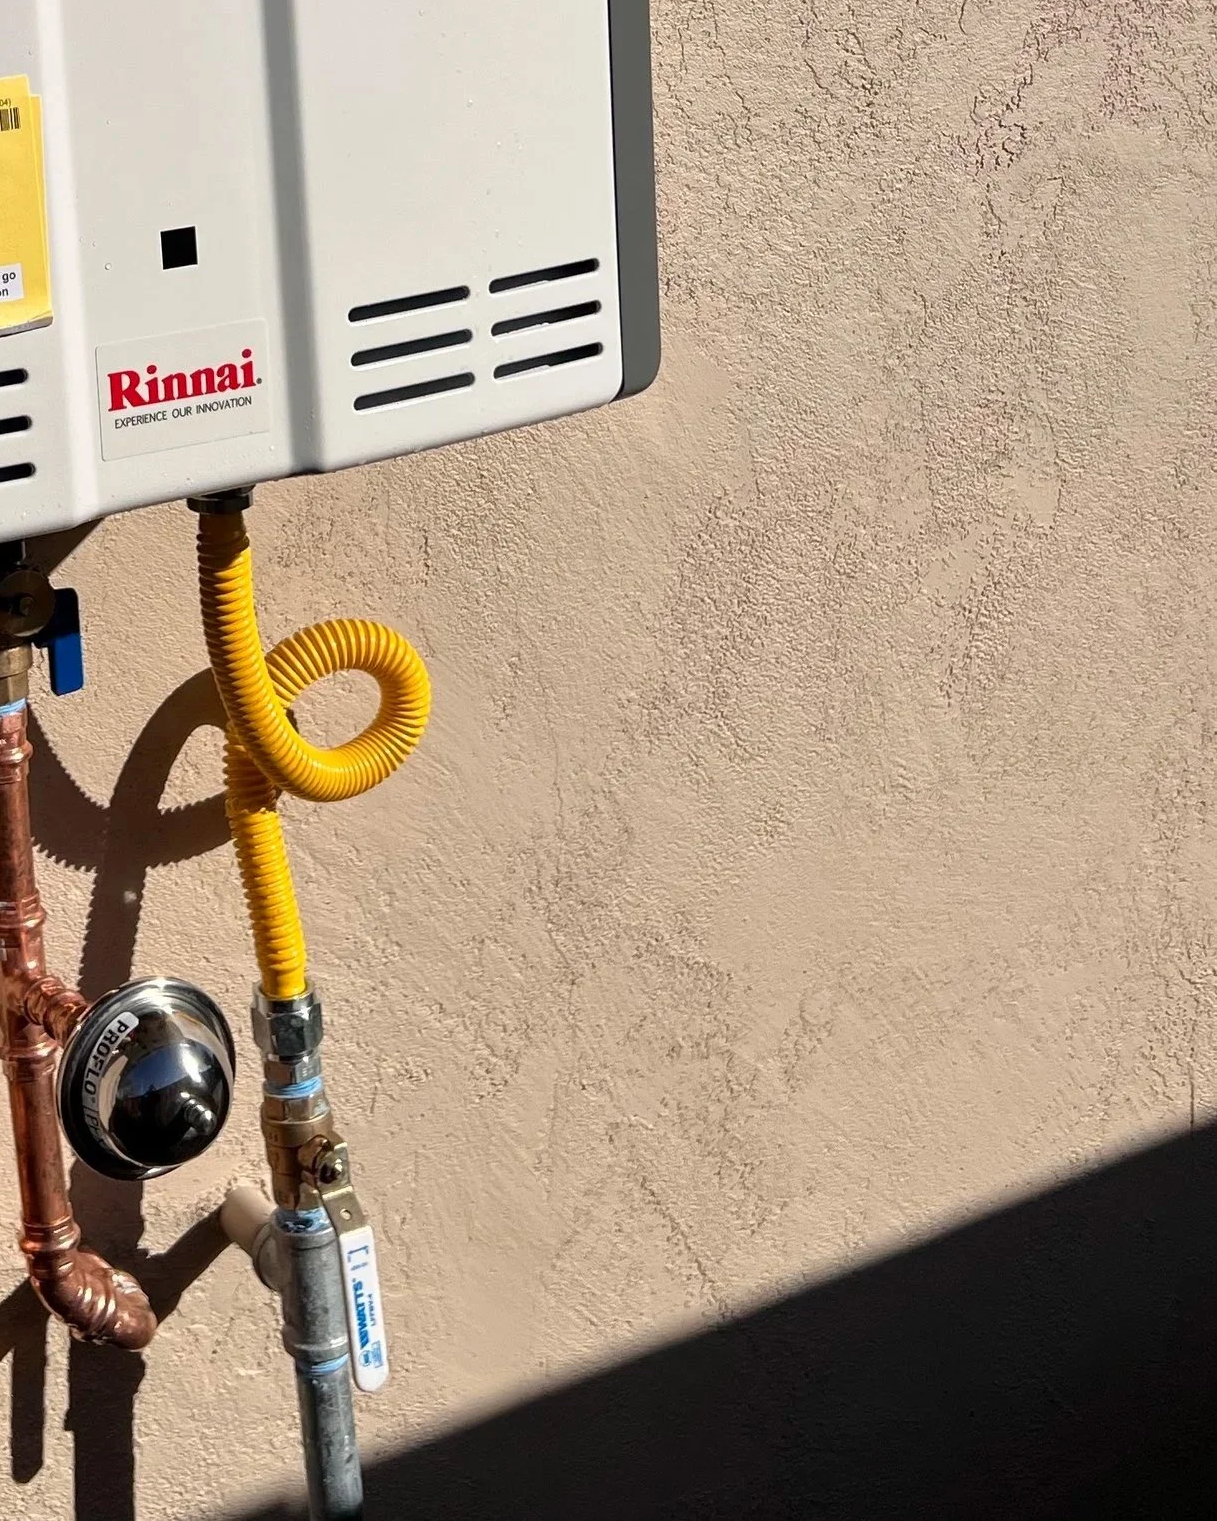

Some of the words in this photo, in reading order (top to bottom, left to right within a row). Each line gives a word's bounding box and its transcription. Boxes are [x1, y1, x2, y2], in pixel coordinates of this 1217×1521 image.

[1, 271, 16, 284] go
[114, 410, 168, 429] EXPERIENCE
[172, 407, 192, 419] OUR
[196, 396, 252, 414] INNOVATION
[84, 1019, 129, 1097] PROFLO
[352, 1280, 370, 1350] WATTS
